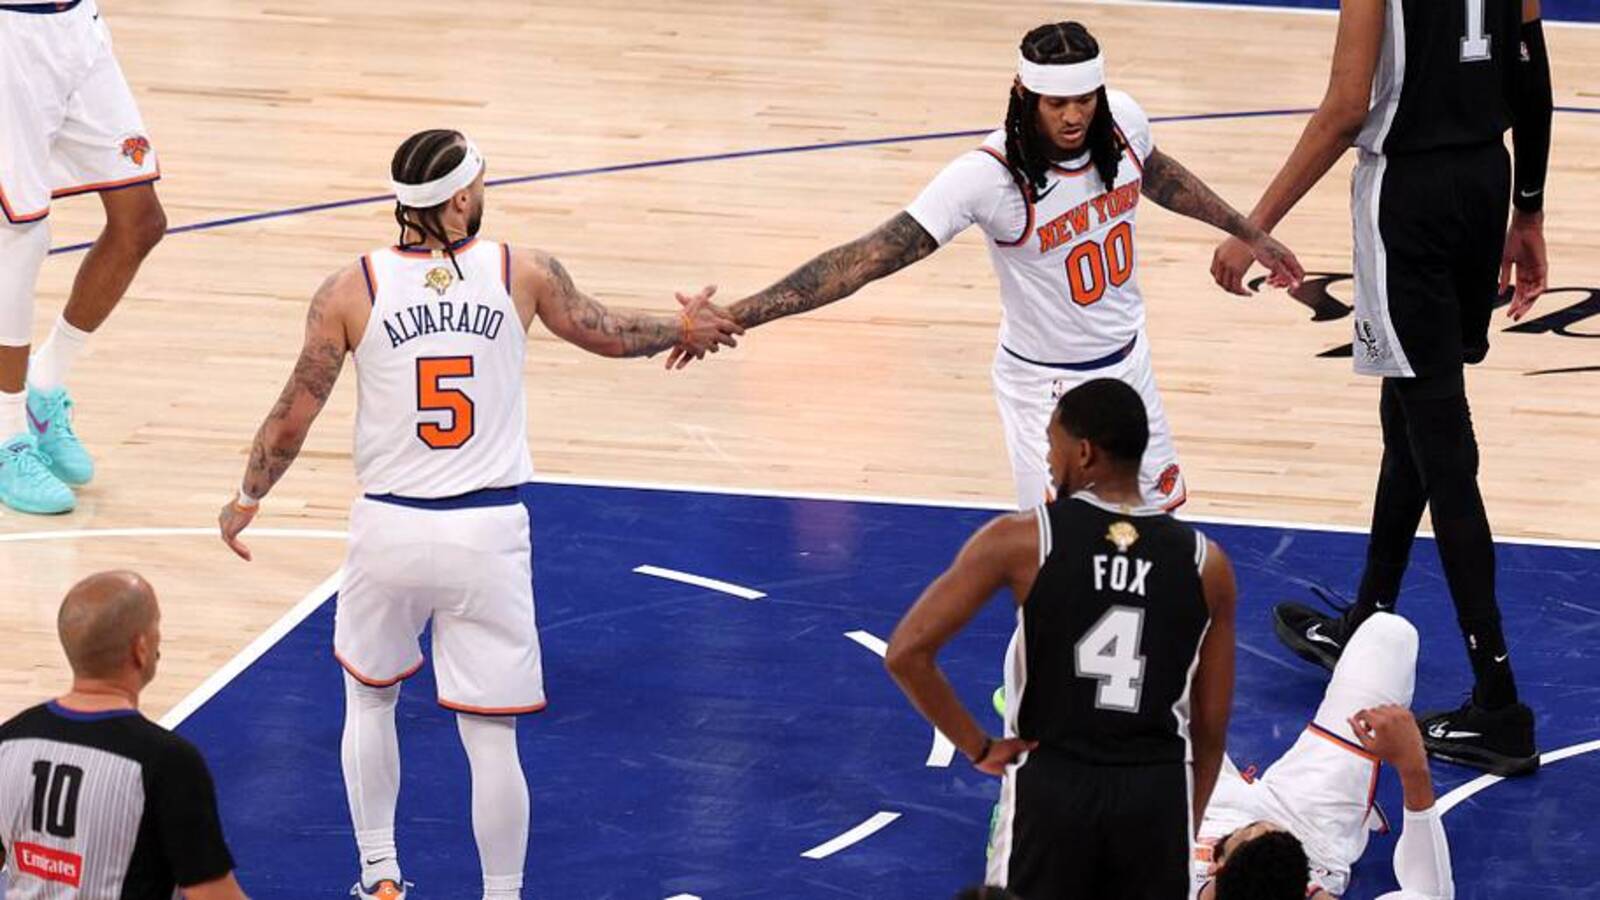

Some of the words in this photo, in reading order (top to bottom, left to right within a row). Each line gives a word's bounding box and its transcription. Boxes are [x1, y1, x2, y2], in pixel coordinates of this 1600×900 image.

[1037, 200, 1089, 253] NEW
[1065, 220, 1134, 306] 00
[383, 301, 504, 348] ALVARADO
[416, 355, 475, 449] 5
[1093, 554, 1153, 596] FOX
[1074, 604, 1147, 713] 4
[31, 760, 84, 838] 10
[22, 849, 76, 877] Emirates
